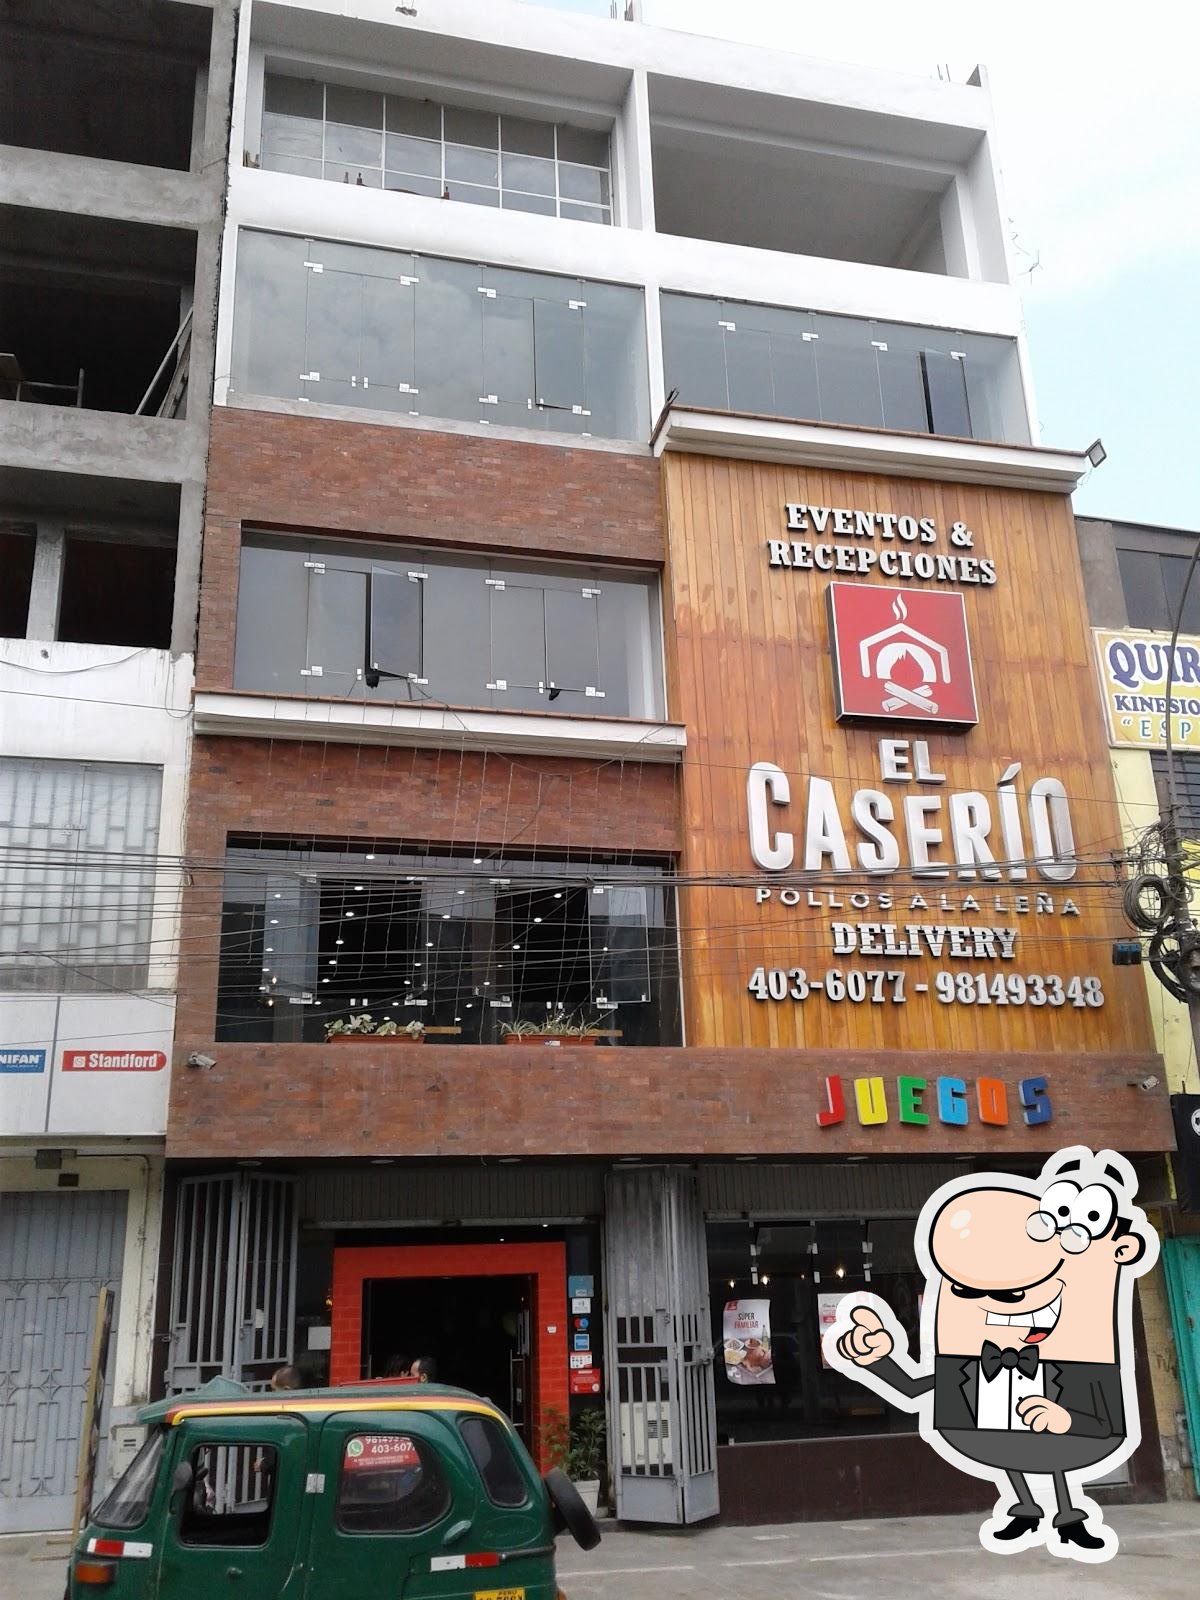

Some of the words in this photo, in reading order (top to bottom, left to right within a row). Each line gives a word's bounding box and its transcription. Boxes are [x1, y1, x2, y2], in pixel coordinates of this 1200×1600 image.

[784, 503, 938, 544] EVENTOS
[950, 520, 974, 548] &
[768, 540, 998, 586] RECEPCIONES
[879, 739, 946, 784] EL
[746, 761, 1078, 881] CASERÍO
[756, 887, 893, 909] POLLOS
[909, 892, 929, 910] A
[938, 893, 980, 912] LA
[994, 891, 1080, 916] LEÑA
[831, 922, 1017, 958] DELIVERY
[748, 967, 906, 1003] 403-6077
[935, 971, 1105, 1008] 981493348
[89, 1053, 157, 1068] Standford
[816, 1075, 1053, 1127] JUEGOS
